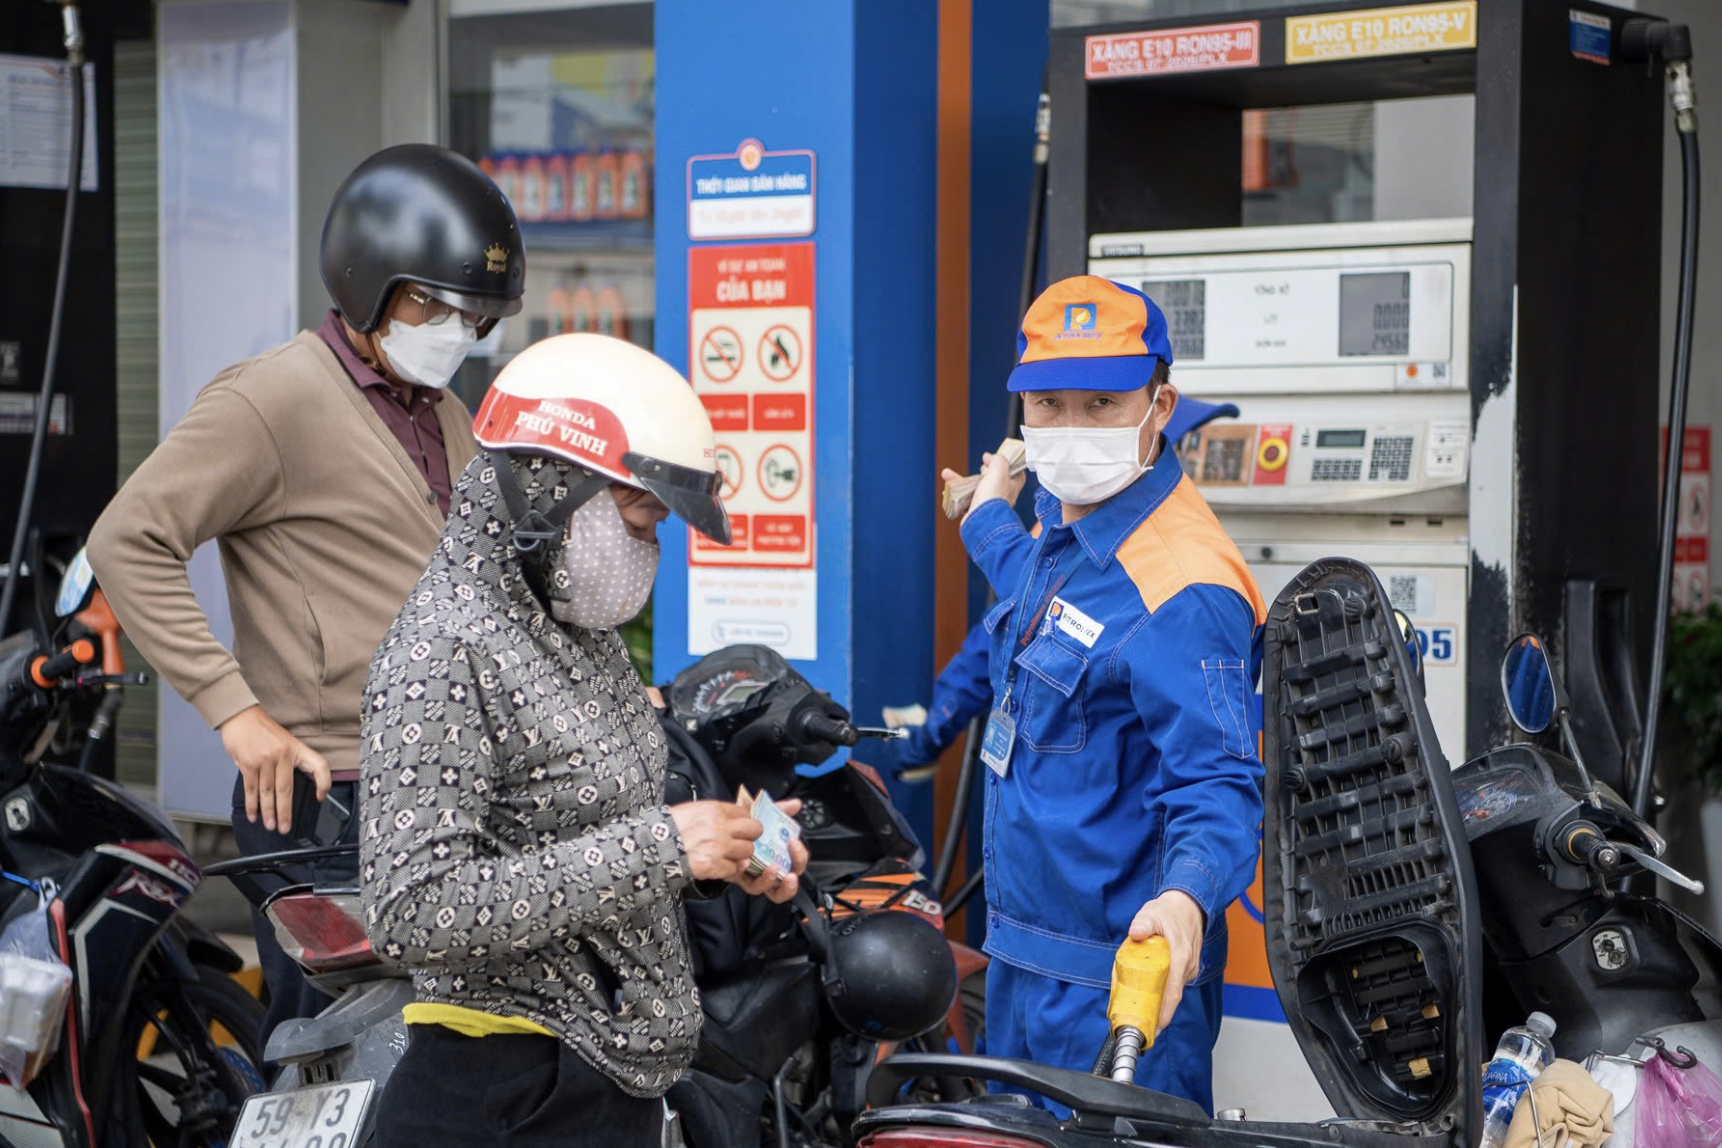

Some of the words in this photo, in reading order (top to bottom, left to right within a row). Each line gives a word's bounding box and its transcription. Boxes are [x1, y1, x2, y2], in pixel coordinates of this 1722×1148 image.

[1352, 20, 1383, 39] E10
[1388, 12, 1466, 35] RON95-V
[1143, 38, 1173, 58] E10
[1176, 31, 1250, 54] RON95-III
[487, 261, 506, 274] Royal
[717, 274, 750, 302] CỦA
[752, 279, 786, 304] BẠN
[538, 400, 597, 431] HONDA
[515, 411, 553, 435] PHÚ
[558, 426, 608, 456] VINH
[1063, 613, 1096, 639] PTROLEX
[902, 891, 942, 916] 150
[389, 1032, 406, 1055] 310
[1483, 1071, 1508, 1083] UAFINA
